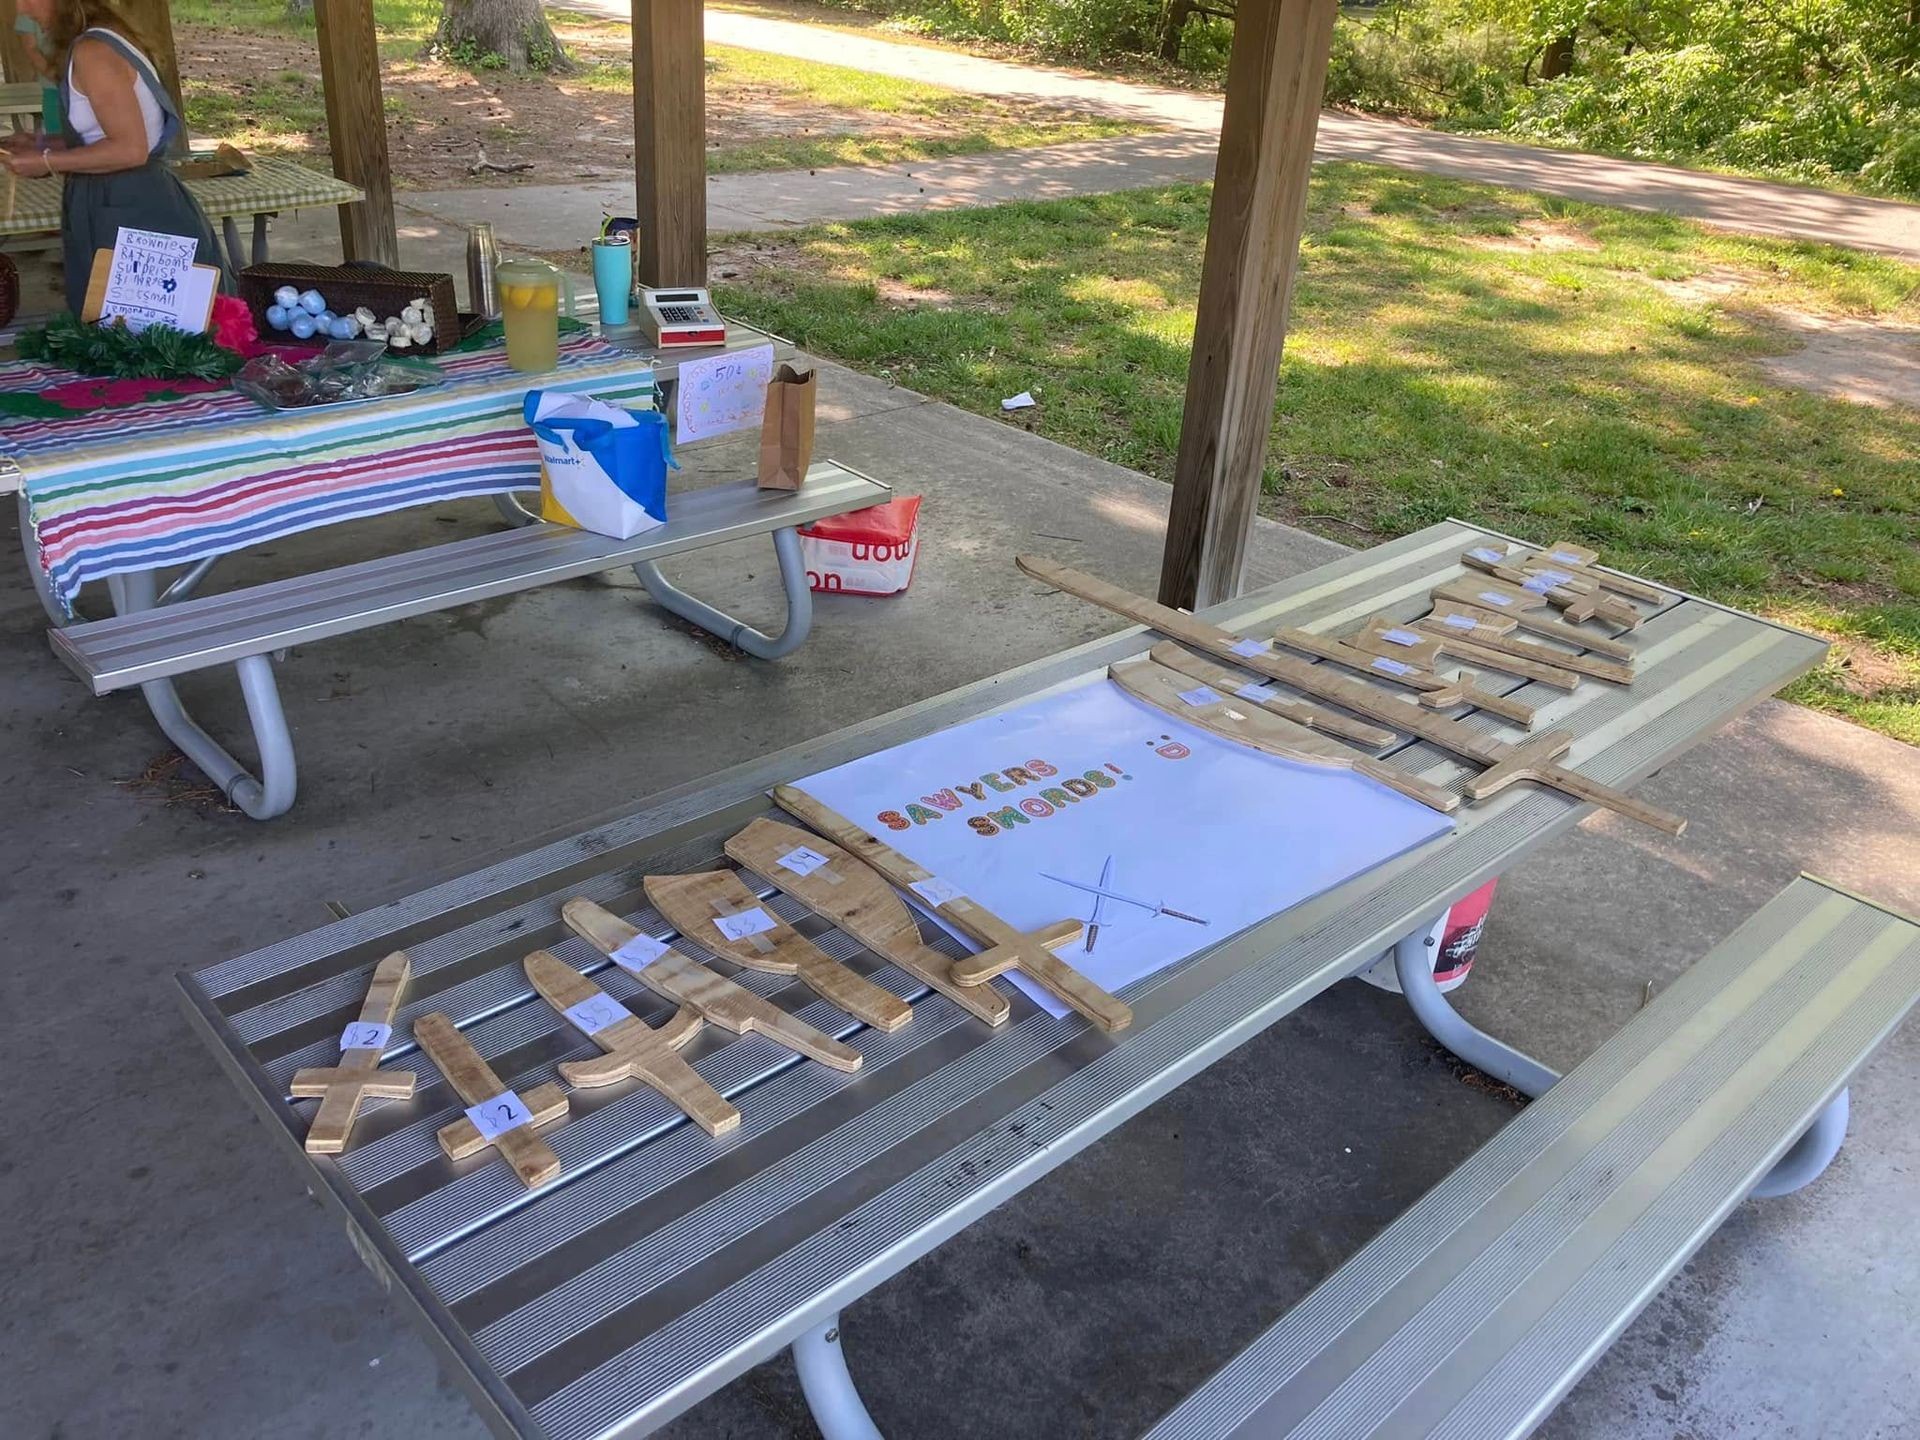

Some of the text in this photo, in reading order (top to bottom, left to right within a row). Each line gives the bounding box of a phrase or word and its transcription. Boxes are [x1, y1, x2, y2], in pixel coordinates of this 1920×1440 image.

[876, 759, 1058, 831] SAWYERS
[967, 763, 1133, 836] SWORDS!
[347, 1024, 380, 1046] $2
[479, 1104, 519, 1129] $2
